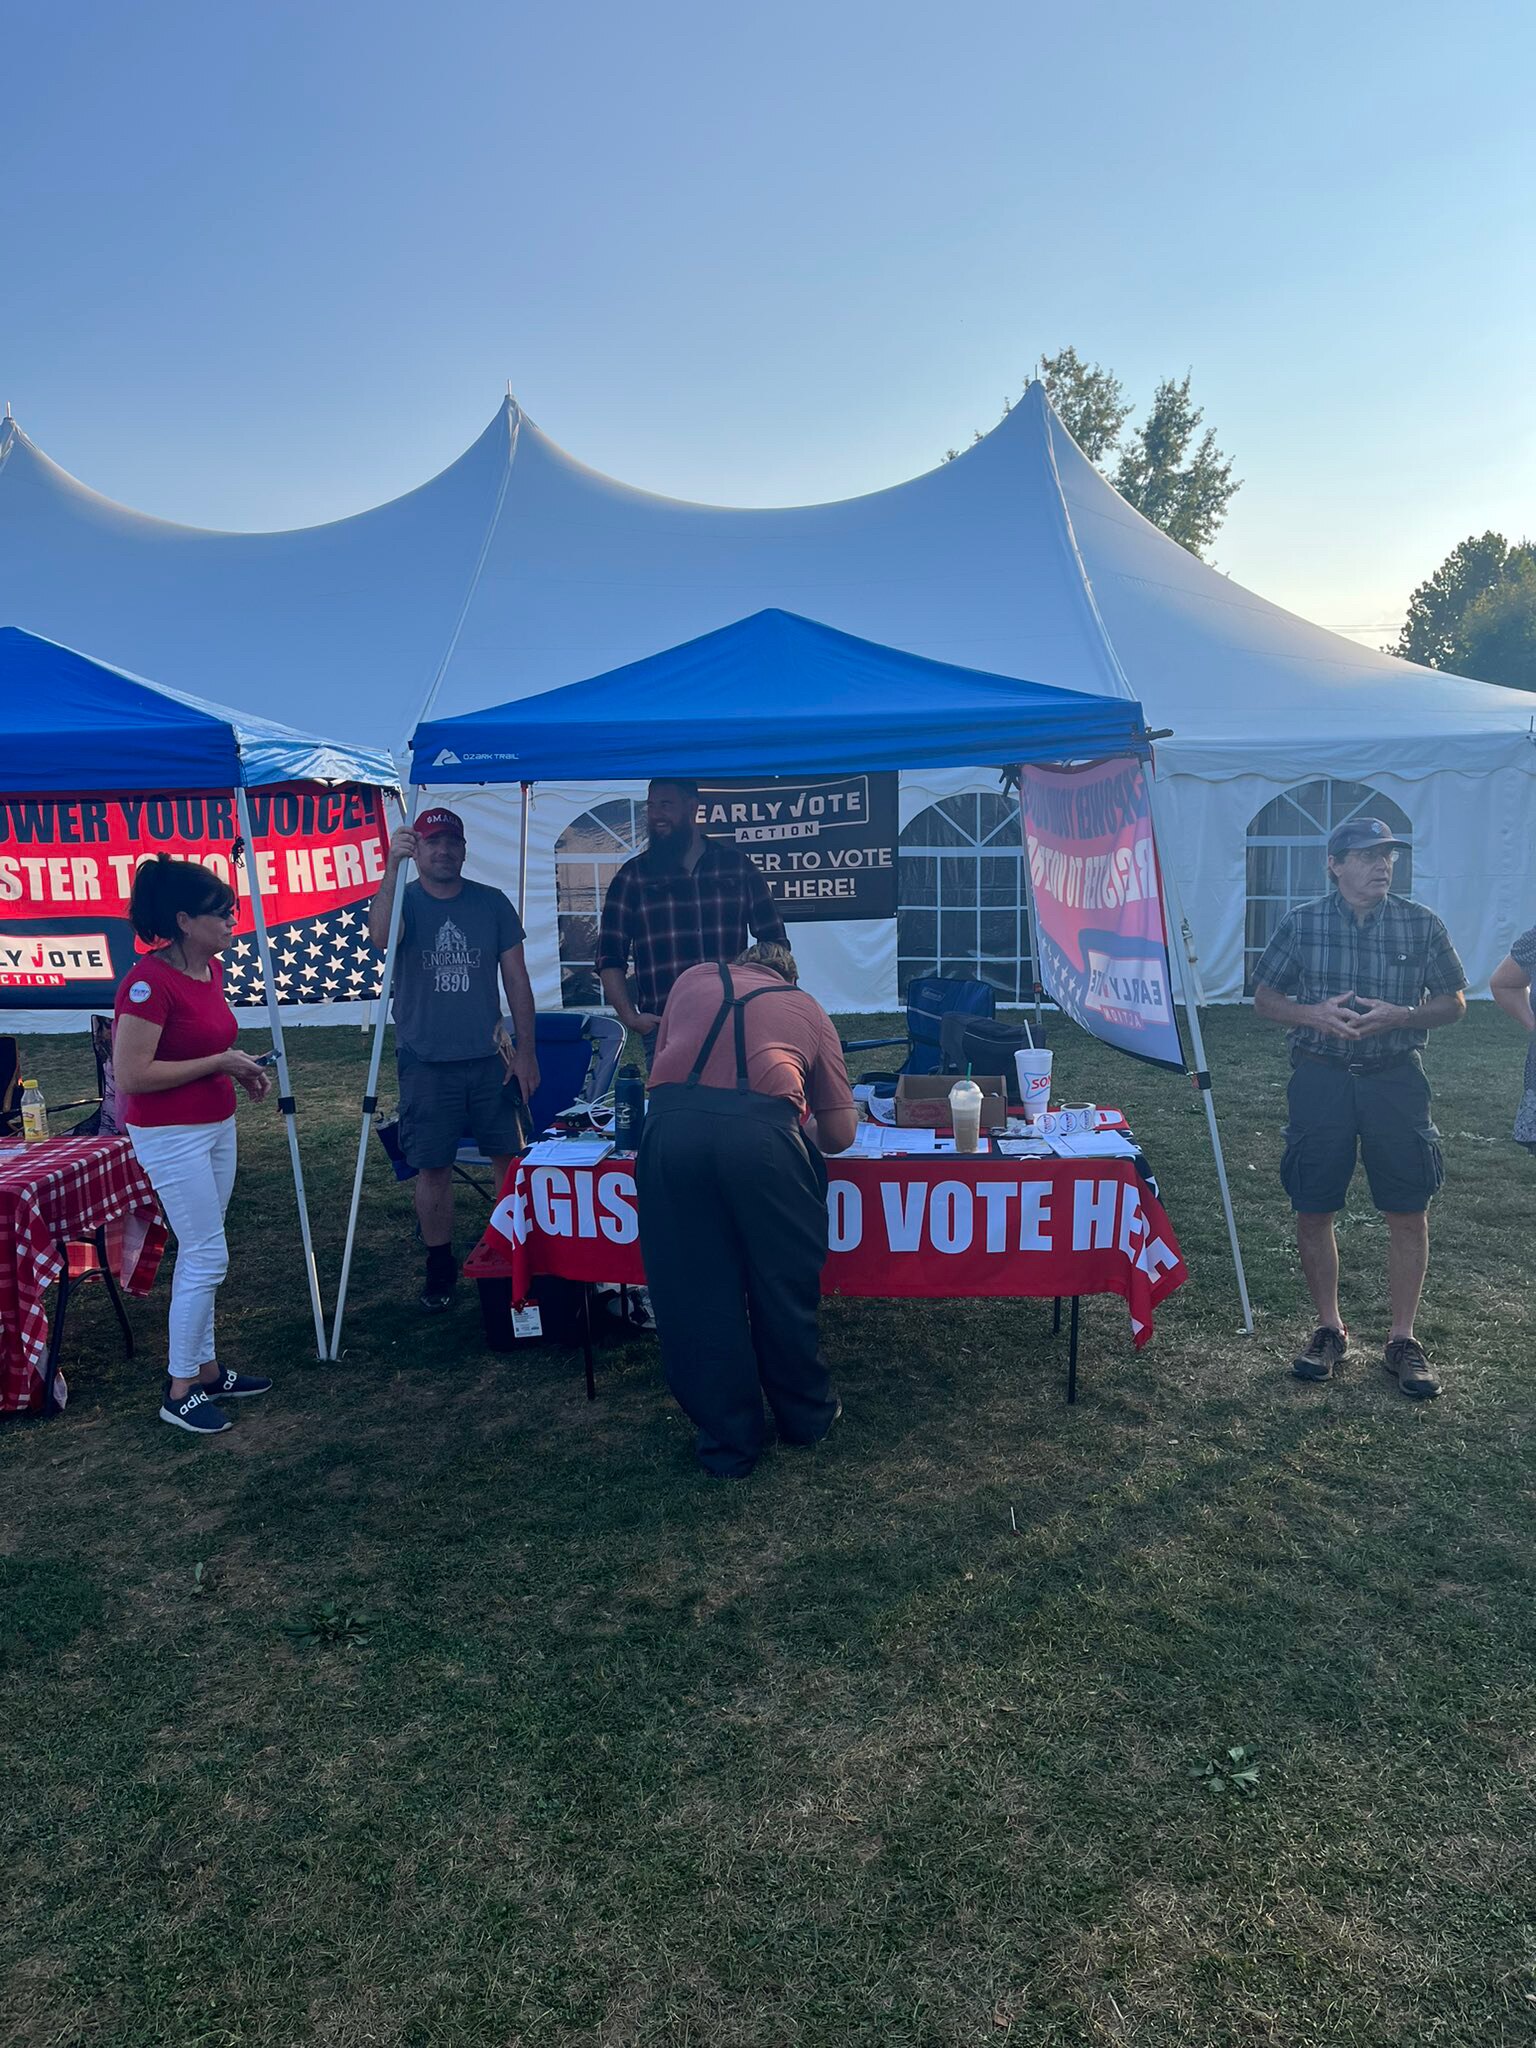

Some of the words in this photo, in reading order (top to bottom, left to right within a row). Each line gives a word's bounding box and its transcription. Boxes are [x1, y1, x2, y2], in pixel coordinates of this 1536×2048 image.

[116, 795, 235, 841] YOUR
[244, 785, 377, 838] VOICE!
[695, 801, 783, 824] EARLY
[740, 823, 814, 841] ACTION
[788, 851, 821, 869] TO
[827, 848, 893, 868] VOTE
[784, 878, 856, 898] HERE!
[430, 952, 473, 966] NORMAL
[434, 974, 470, 992] 1890
[880, 1179, 1054, 1254] VOTE
